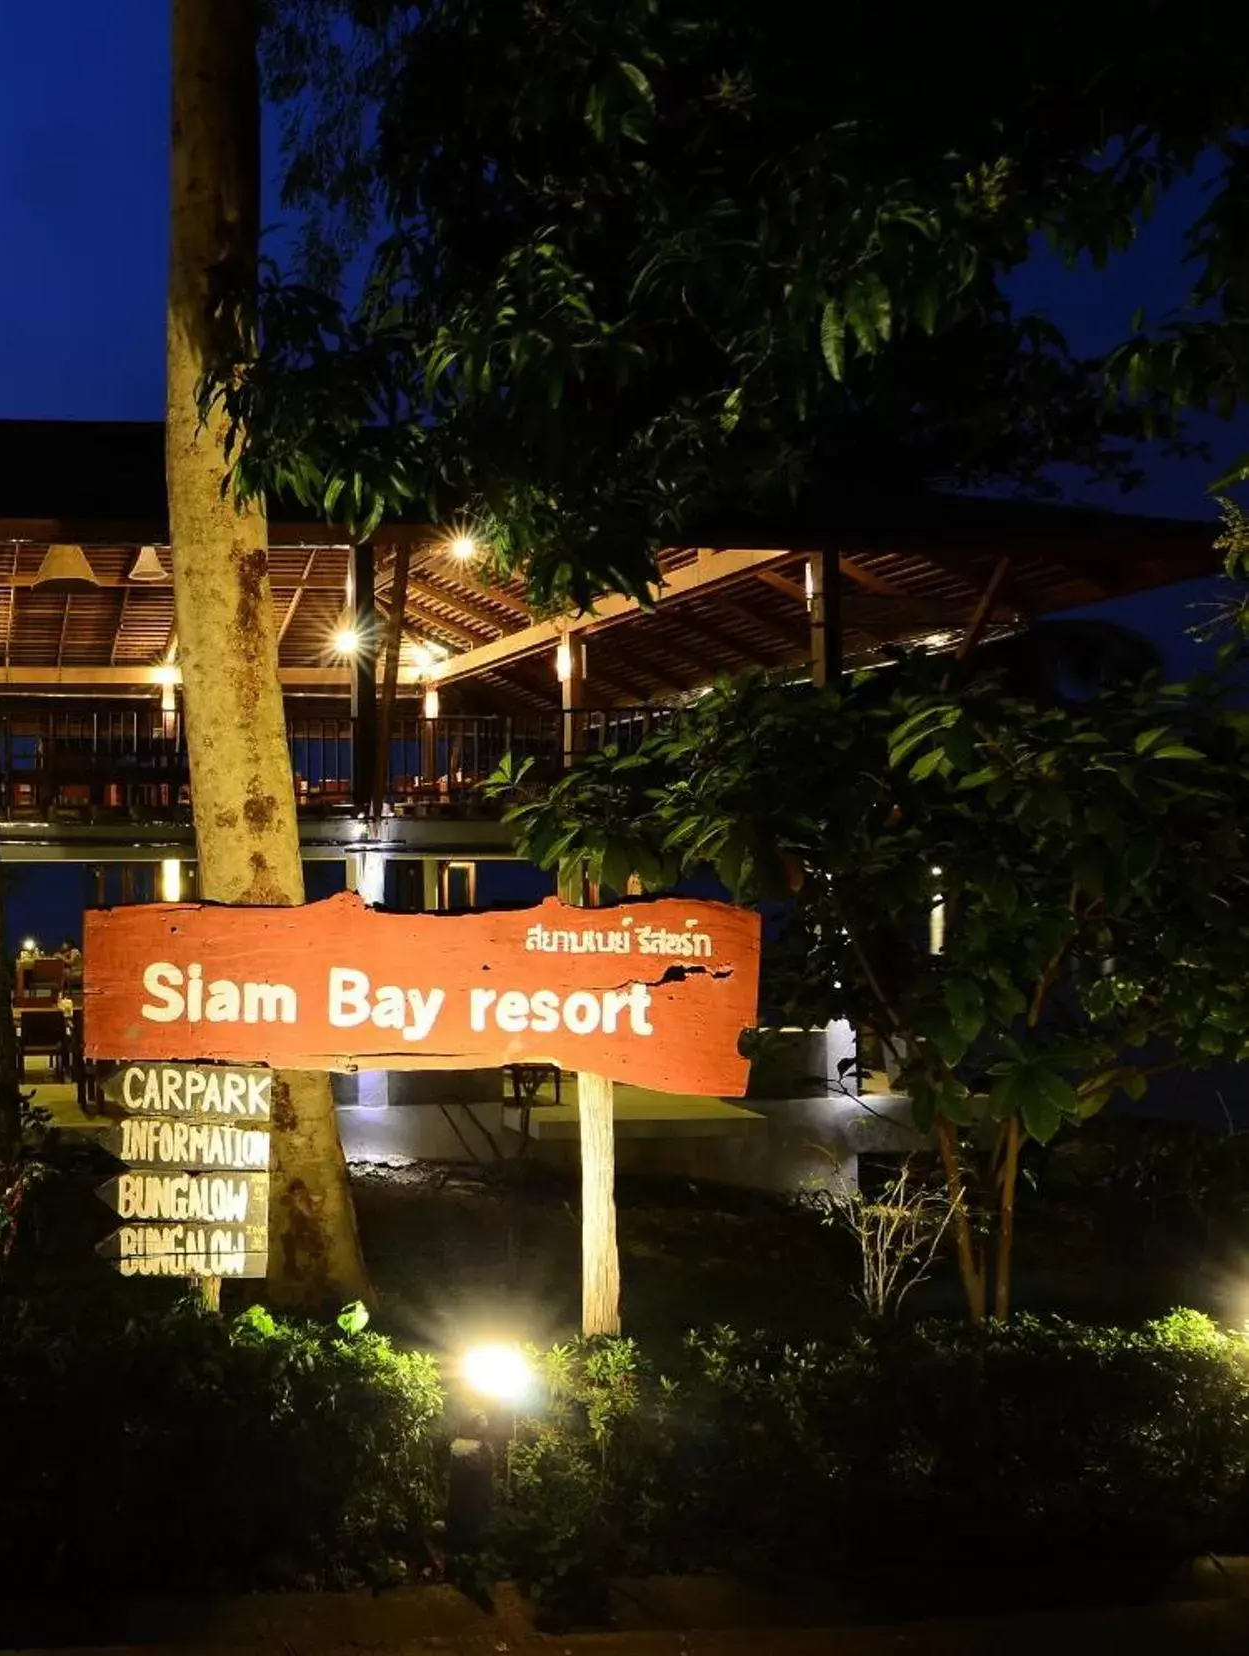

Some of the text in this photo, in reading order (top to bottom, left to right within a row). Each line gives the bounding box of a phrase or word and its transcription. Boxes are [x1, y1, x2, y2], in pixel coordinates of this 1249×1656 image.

[142, 962, 652, 1041] Siam Bay resort
[123, 1067, 270, 1114] CARPARK
[120, 1120, 269, 1167] INFORMATION
[118, 1175, 248, 1222] BUNGALOW
[119, 1224, 245, 1277] BUNGALOW
